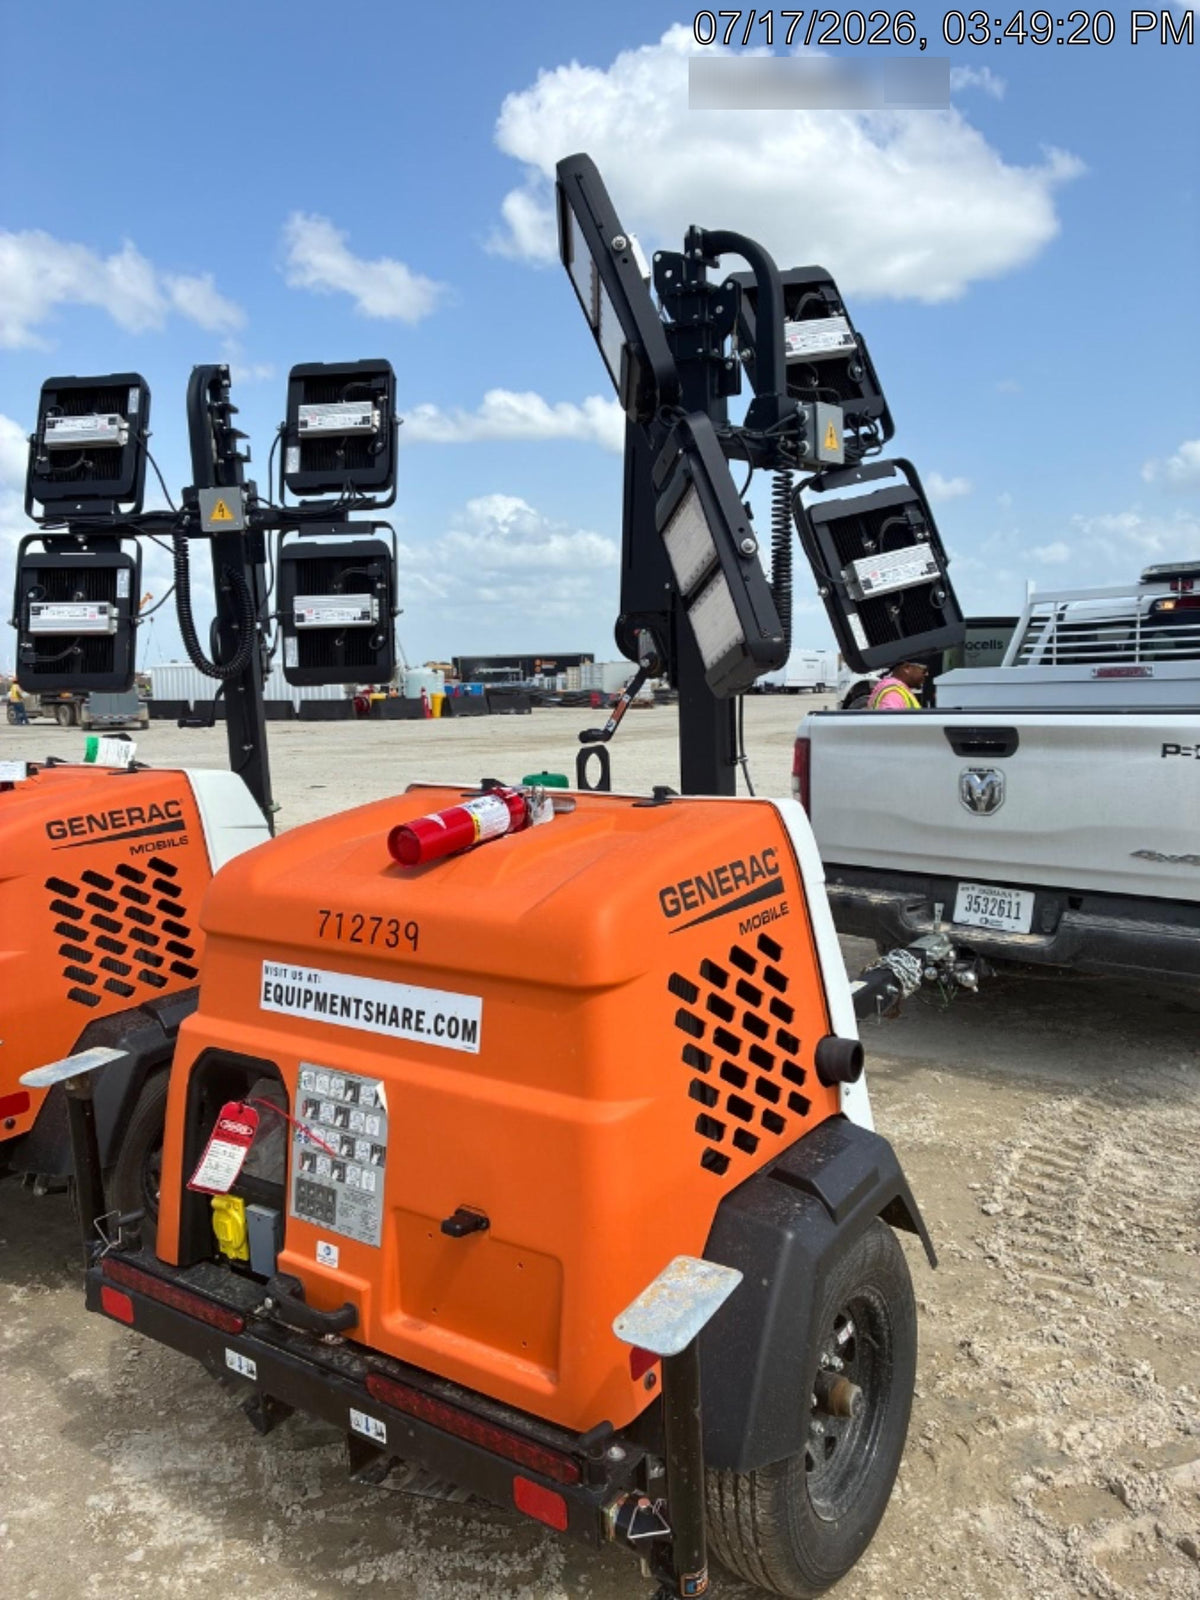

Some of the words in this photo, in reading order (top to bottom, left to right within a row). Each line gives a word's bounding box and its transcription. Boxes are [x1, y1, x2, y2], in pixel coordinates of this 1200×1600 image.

[45, 800, 182, 840] GENERAC
[129, 835, 189, 855] MOBILE
[658, 847, 780, 918] GENERAC
[738, 901, 790, 936] MOBILE
[964, 894, 1022, 920] 3532611
[318, 910, 419, 951] 712739
[264, 964, 288, 979] VISIT
[290, 970, 303, 982] US
[307, 973, 322, 984] AT:
[263, 981, 478, 1044] EQUIPMENTSHARE.COM
